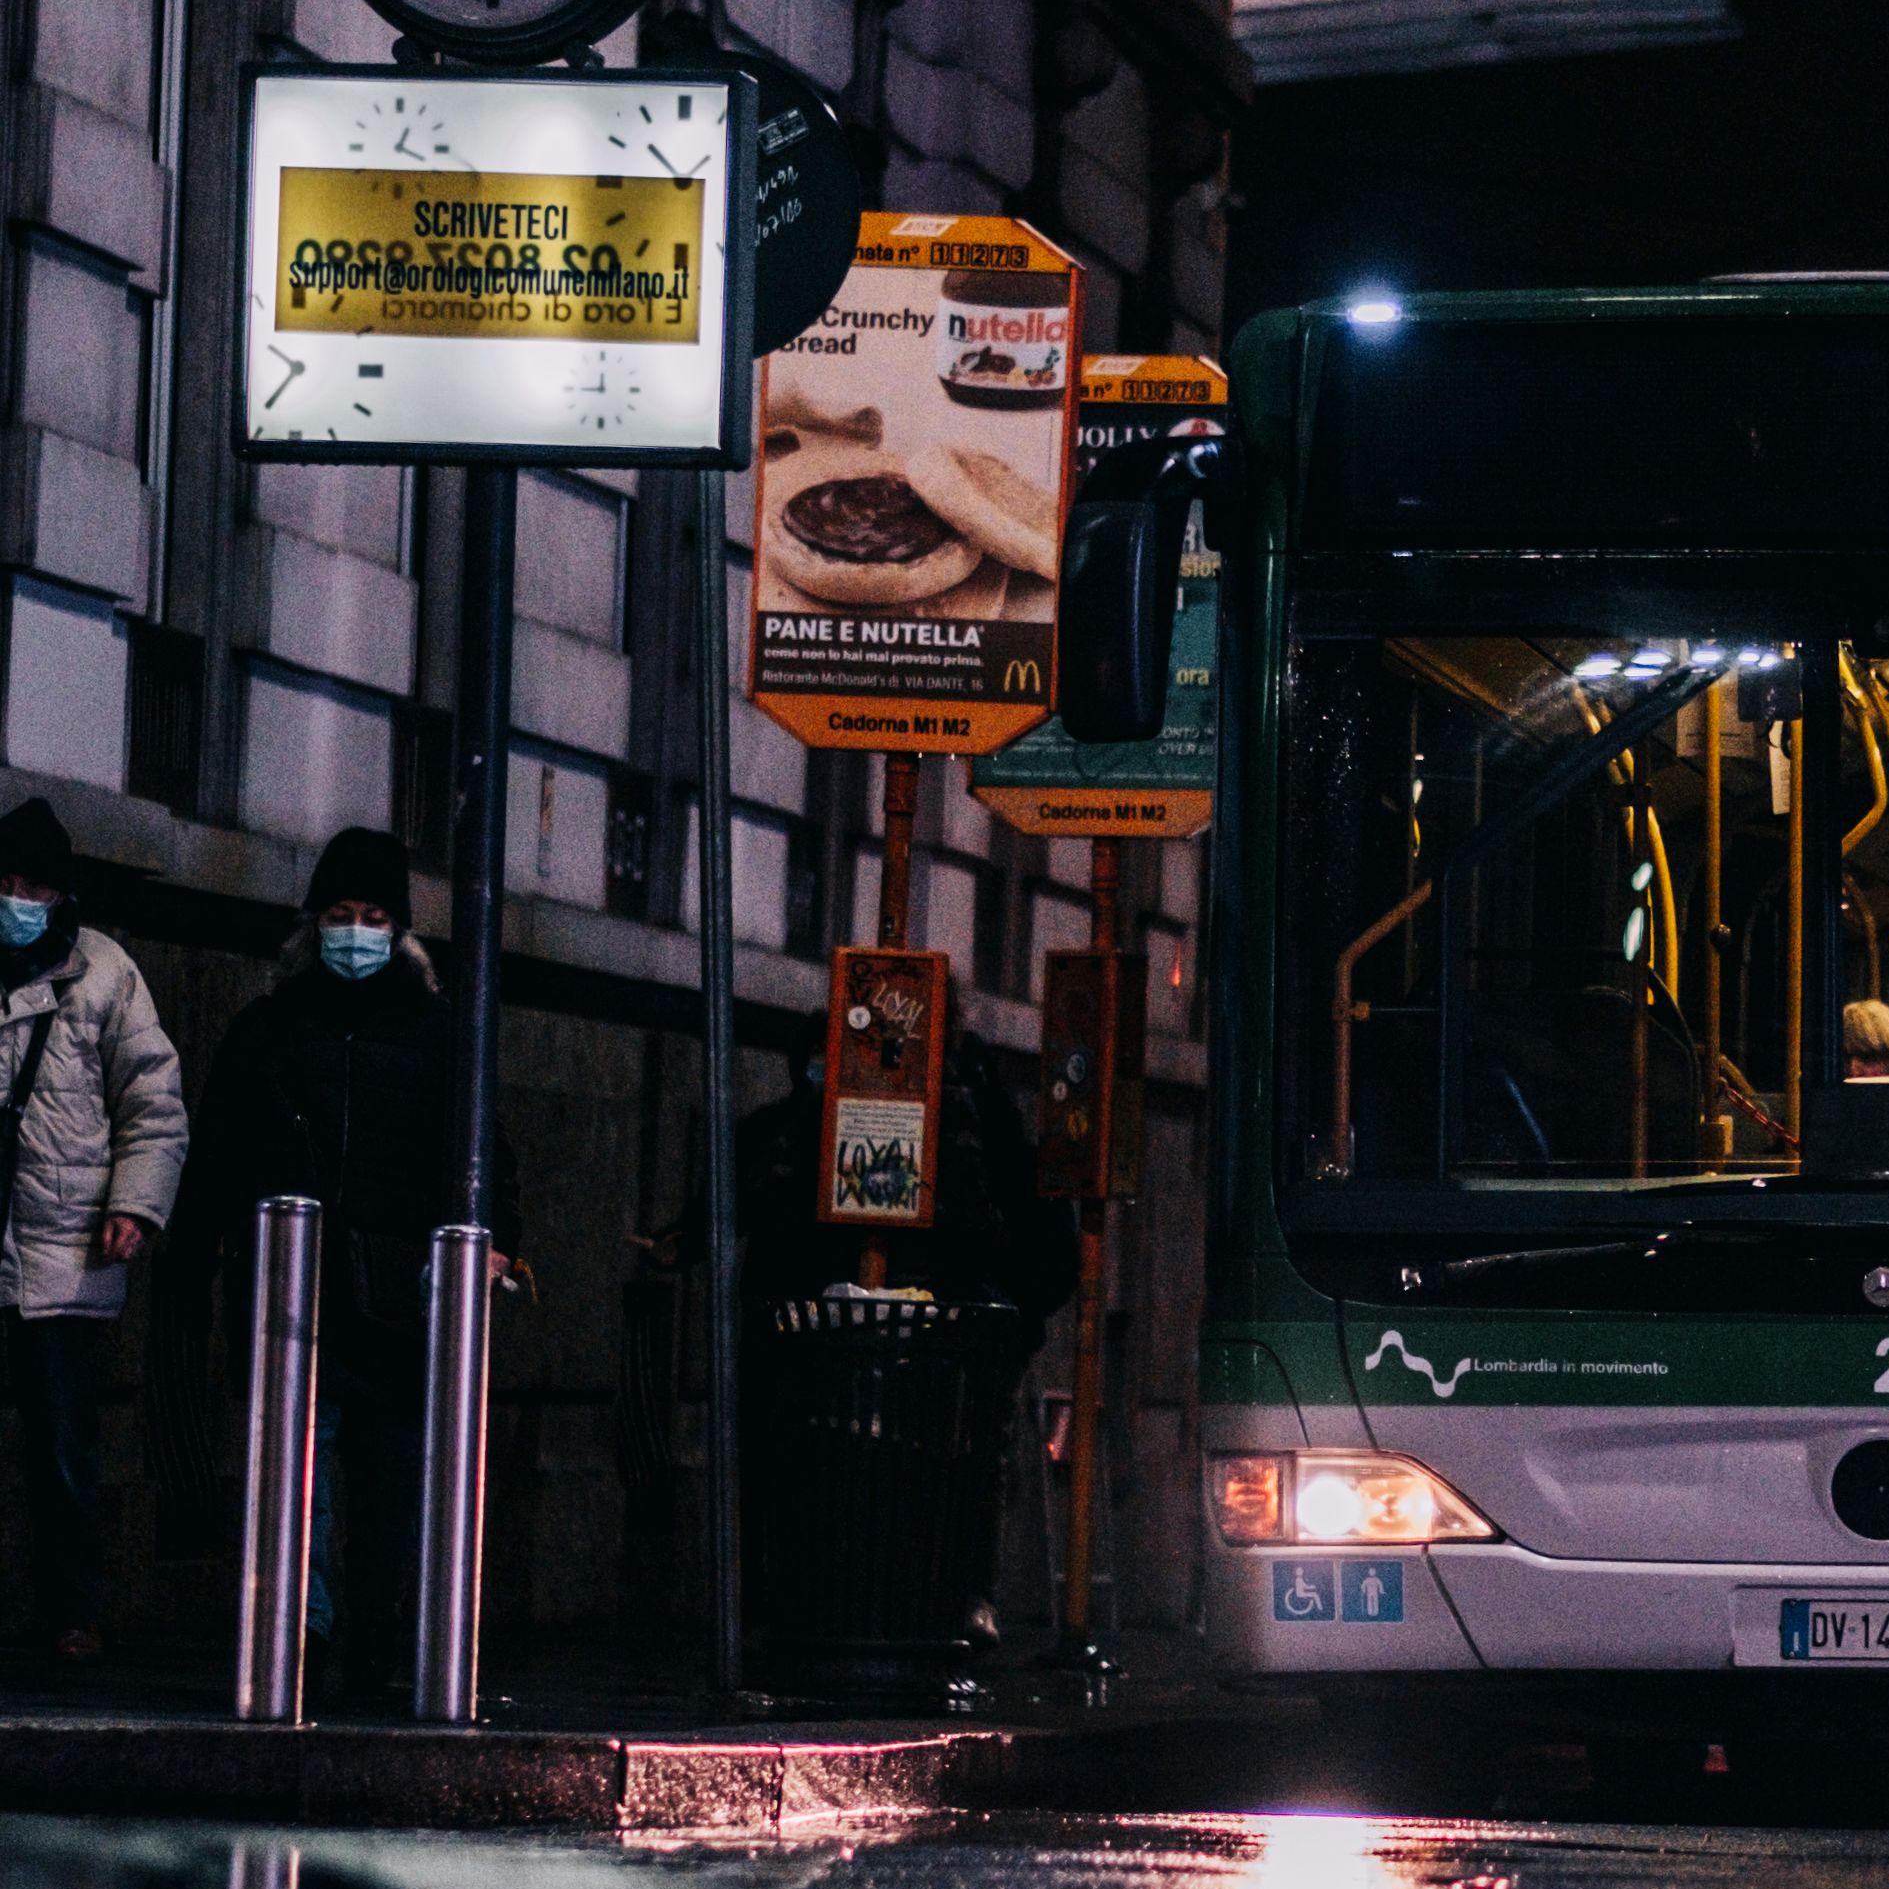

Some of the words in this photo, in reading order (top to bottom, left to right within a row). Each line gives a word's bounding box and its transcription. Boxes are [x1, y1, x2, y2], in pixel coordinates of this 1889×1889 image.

[414, 200, 568, 240] SCRIVETECI
[932, 243, 1028, 267] 11273
[821, 306, 935, 337] Crunchy
[948, 311, 1067, 344] nutella
[764, 617, 833, 641] PANE
[839, 621, 854, 643] E
[764, 649, 800, 659] come
[802, 650, 826, 660] non
[828, 648, 841, 661] lo
[843, 649, 863, 662] hai
[865, 650, 890, 663] mai
[892, 653, 941, 666] provato
[763, 670, 820, 684] Ristorante
[821, 672, 886, 687] McDonald's
[905, 676, 924, 689] VIA
[828, 713, 909, 734] Cadorna
[914, 716, 938, 735] M1
[943, 717, 971, 737] M2
[1039, 802, 1112, 821] Cadorna
[1473, 1358, 1558, 1374] Lombardia
[1562, 1359, 1577, 1374] in
[1581, 1359, 1669, 1376] movimento
